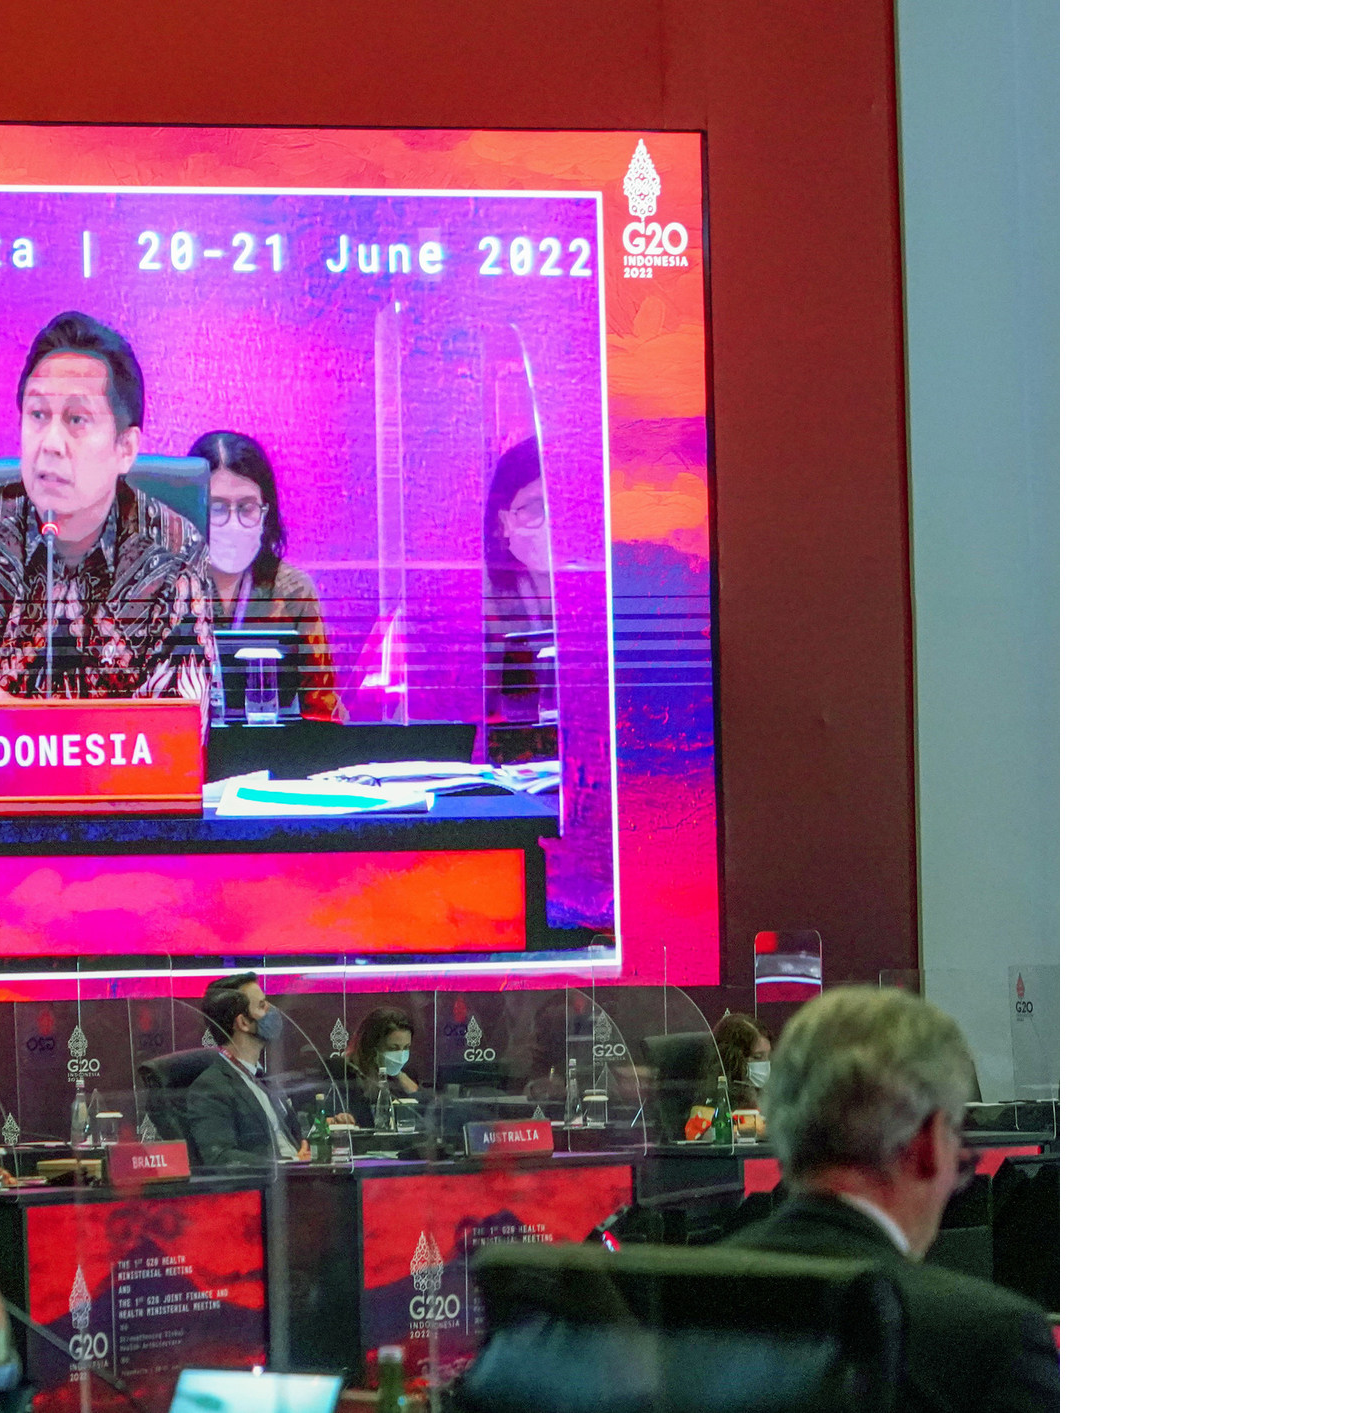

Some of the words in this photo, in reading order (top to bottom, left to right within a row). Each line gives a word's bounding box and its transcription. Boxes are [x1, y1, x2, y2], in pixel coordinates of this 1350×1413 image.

[622, 221, 689, 255] G20
[137, 231, 283, 272] 20-21
[325, 234, 445, 274] June
[478, 237, 592, 277] 2022
[623, 255, 689, 267] INDONESIA
[623, 267, 653, 278] 2022
[464, 1048, 496, 1062] G20
[593, 1044, 626, 1057] G20
[67, 1058, 101, 1073] G20
[483, 1129, 539, 1144] AUSTRALIA
[131, 1155, 168, 1170] BRAZIL
[162, 1255, 186, 1266] HEALTH
[118, 1269, 162, 1281] MINISTERIAL
[165, 1265, 193, 1276] MEETING
[118, 1285, 131, 1294] AND
[163, 1293, 183, 1303] JOINT
[186, 1290, 213, 1301] FINANCE
[217, 1288, 229, 1298] AND
[118, 1308, 144, 1319] HEALTH
[146, 1304, 189, 1316] MINISTERIAL
[193, 1300, 221, 1311] MEETING
[69, 1332, 109, 1360] G20
